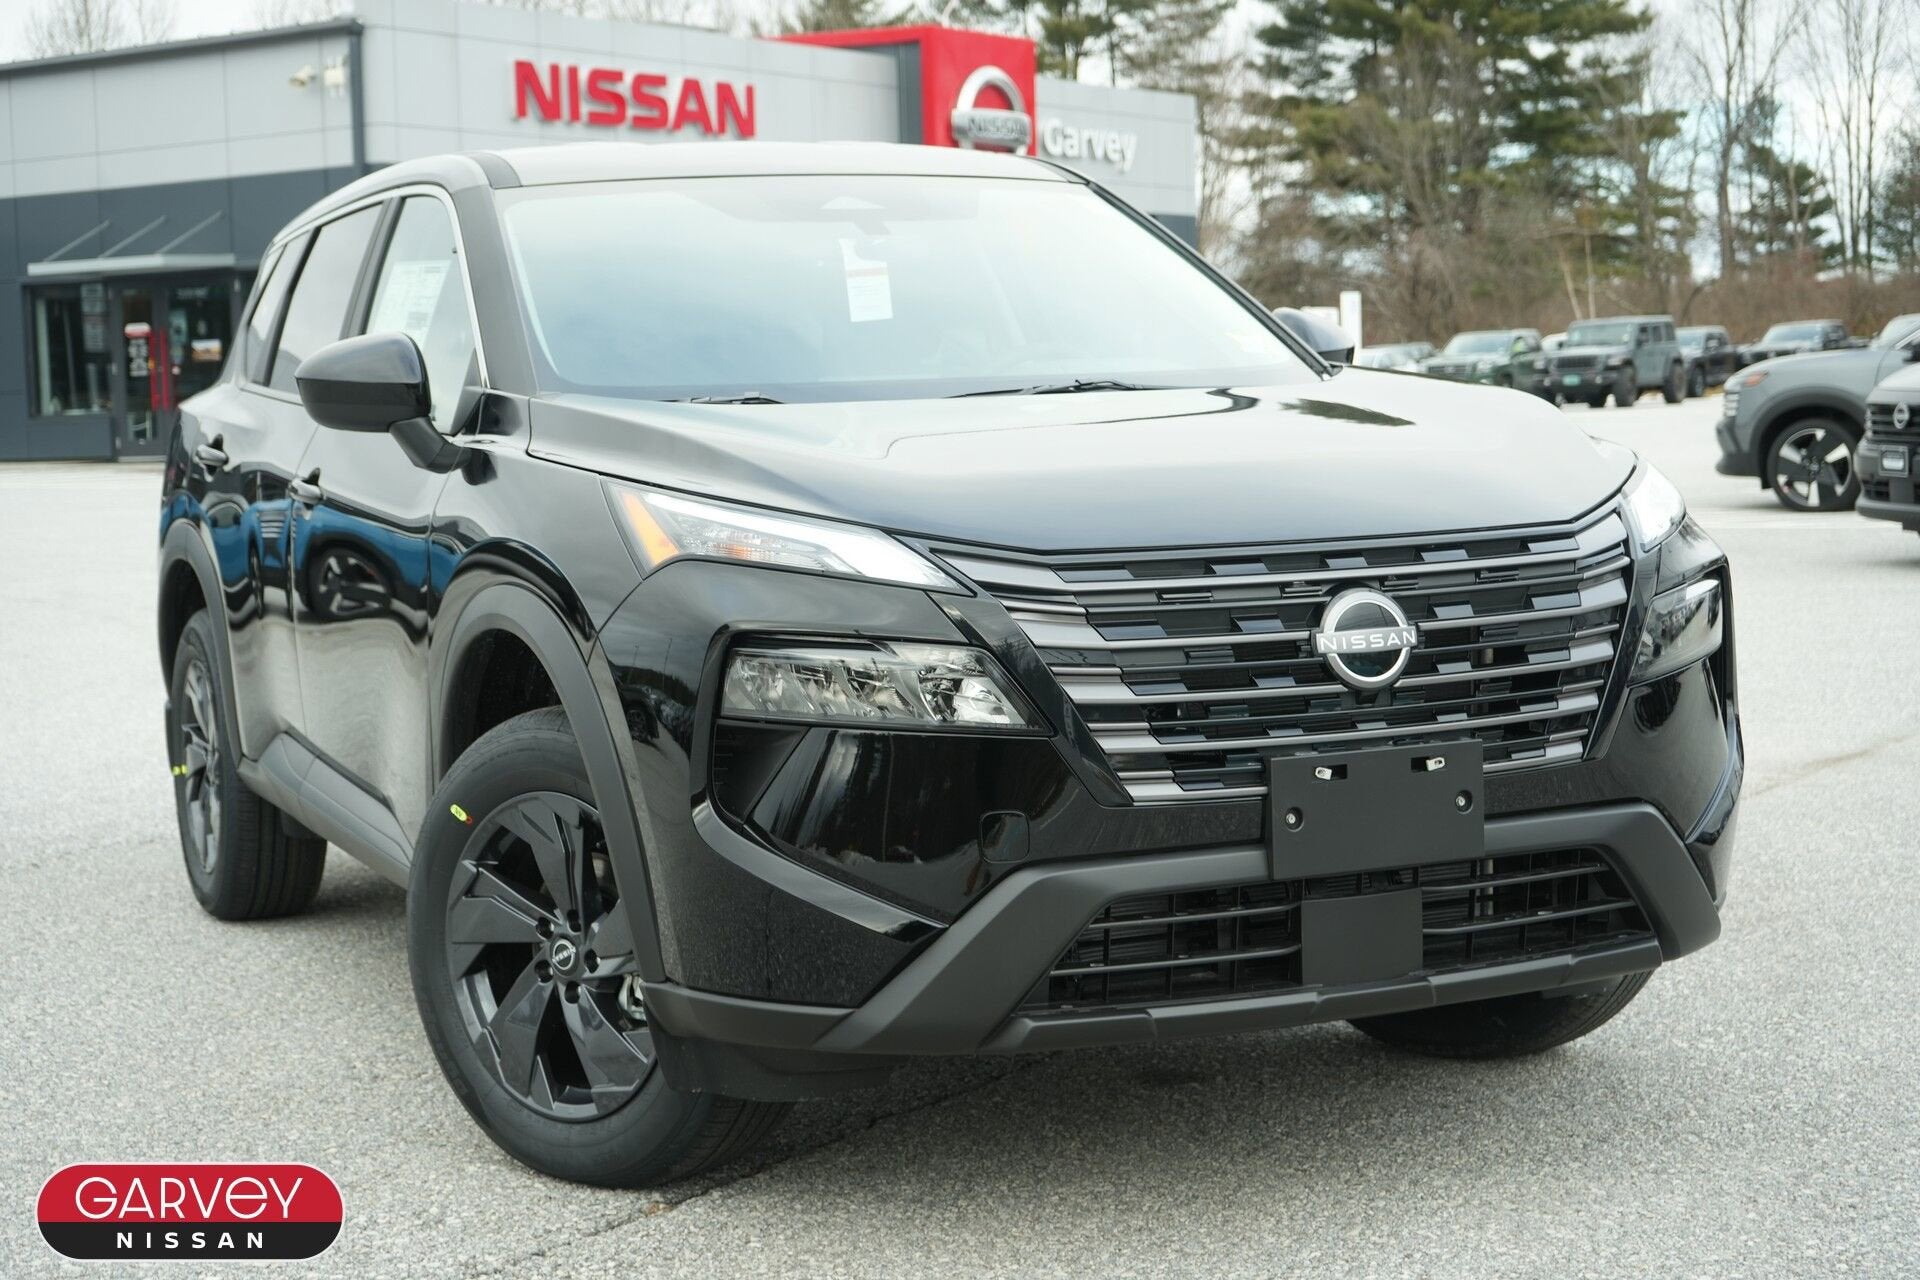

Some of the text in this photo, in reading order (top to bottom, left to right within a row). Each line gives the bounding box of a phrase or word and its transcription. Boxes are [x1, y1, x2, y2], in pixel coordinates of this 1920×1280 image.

[515, 60, 756, 138] NISSAN
[1043, 118, 1138, 173] Garvey
[1319, 630, 1416, 651] NISSAN
